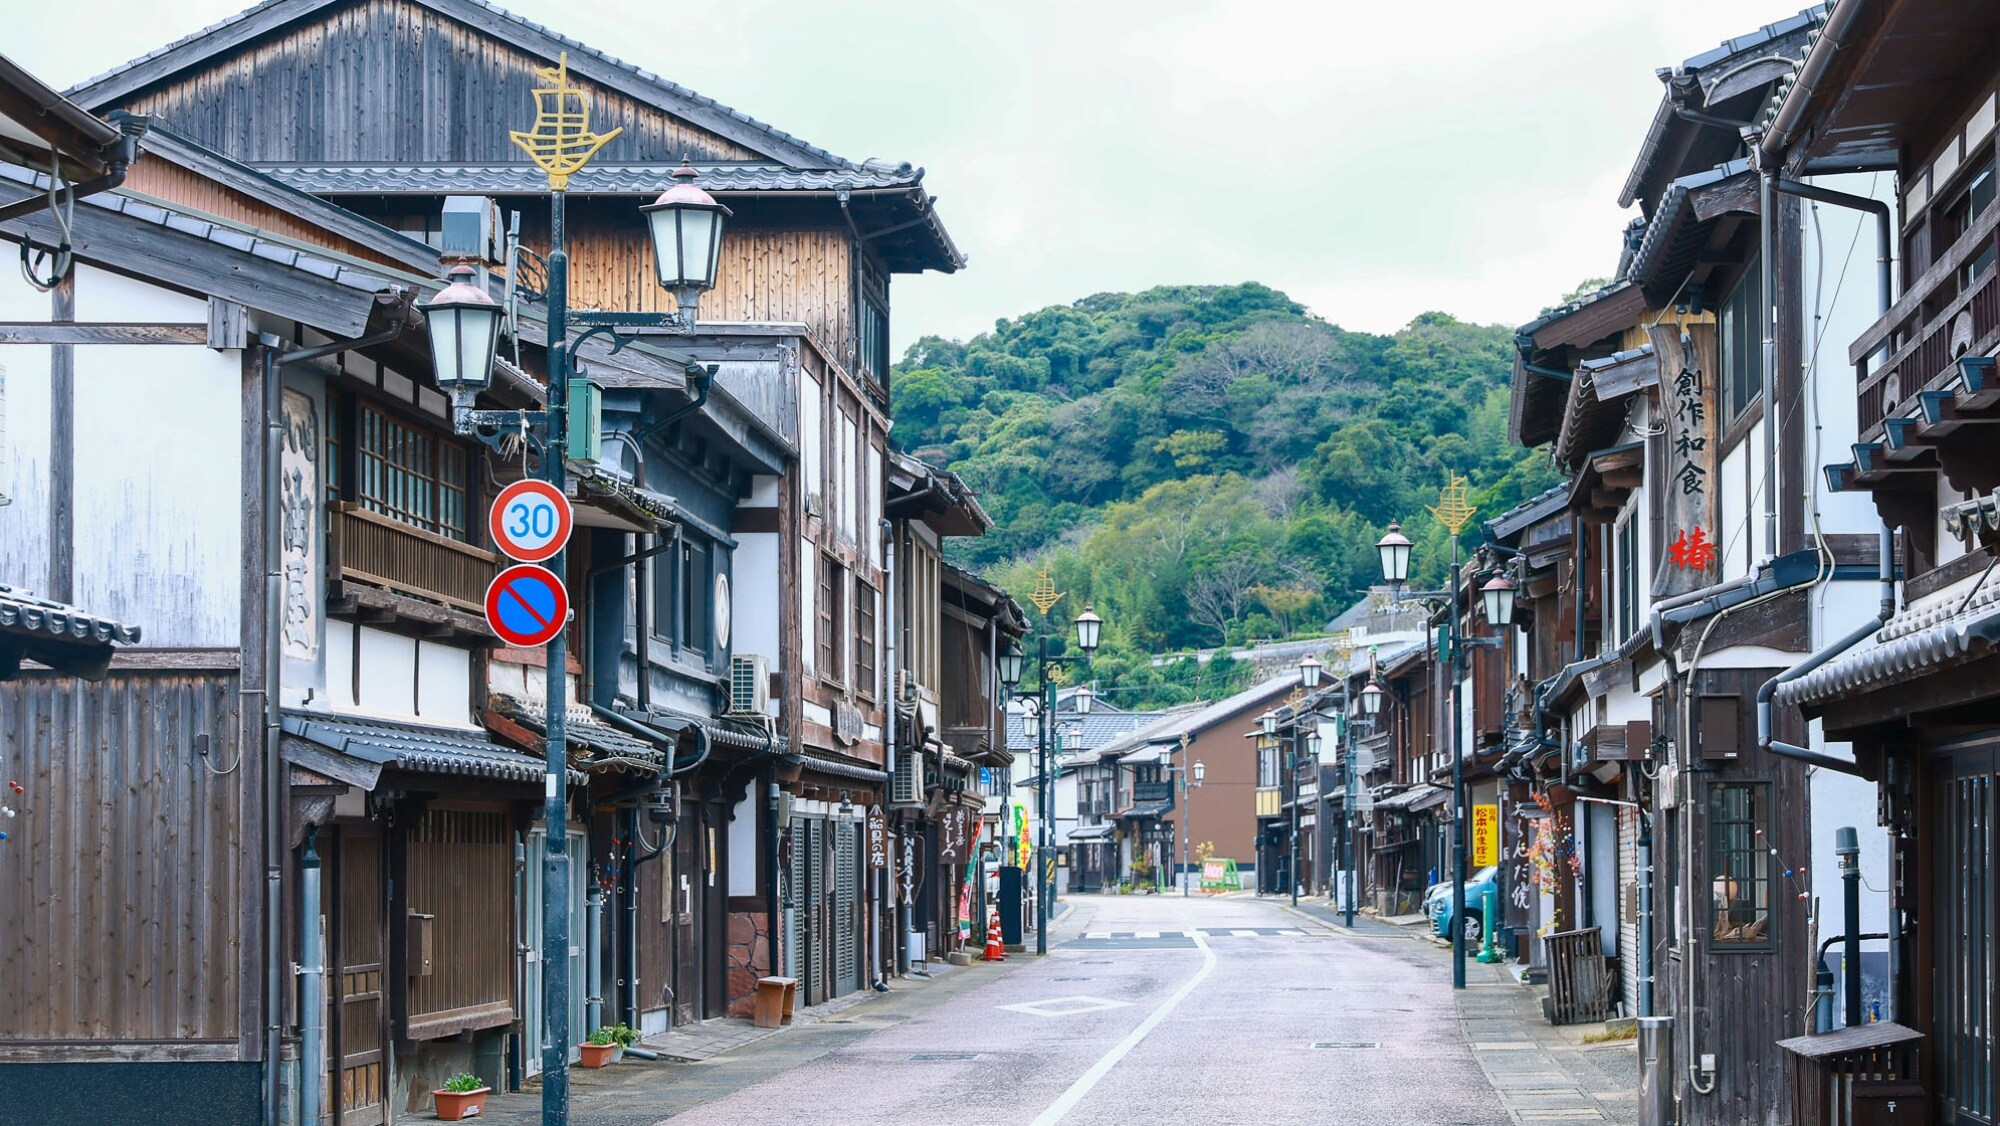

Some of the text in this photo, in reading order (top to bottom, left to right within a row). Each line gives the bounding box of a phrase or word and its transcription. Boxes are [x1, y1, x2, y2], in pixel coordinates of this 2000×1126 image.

[1673, 368, 1706, 495] 創作和食
[510, 503, 553, 539] 30
[1669, 525, 1714, 571] 椿
[869, 817, 885, 866] 船具の店
[1475, 807, 1488, 865] 松本かまぼこ
[903, 837, 915, 905] NARAIYA
